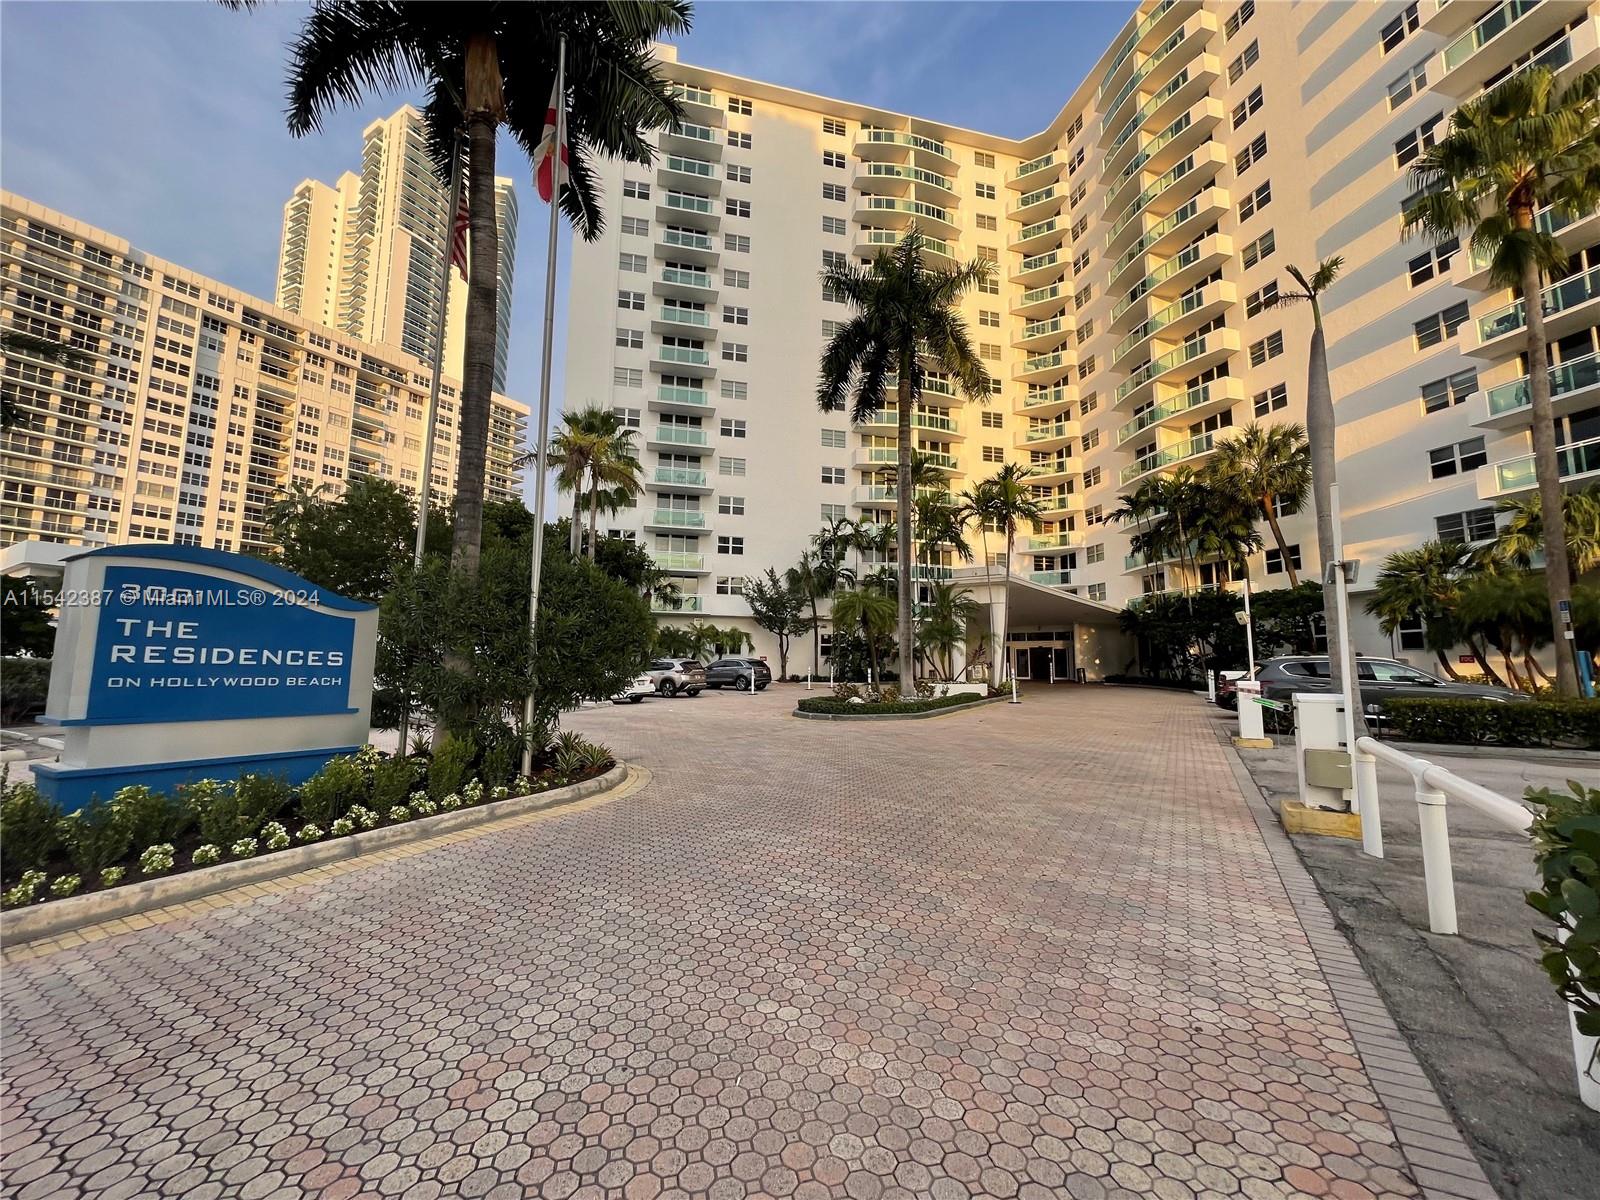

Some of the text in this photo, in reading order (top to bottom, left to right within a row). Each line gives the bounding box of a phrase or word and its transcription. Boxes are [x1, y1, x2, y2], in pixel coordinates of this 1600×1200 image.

[116, 618, 200, 639] THE
[110, 645, 344, 666] RESIDENCES
[107, 677, 342, 688] ON HOLLYWOOD BEACH
